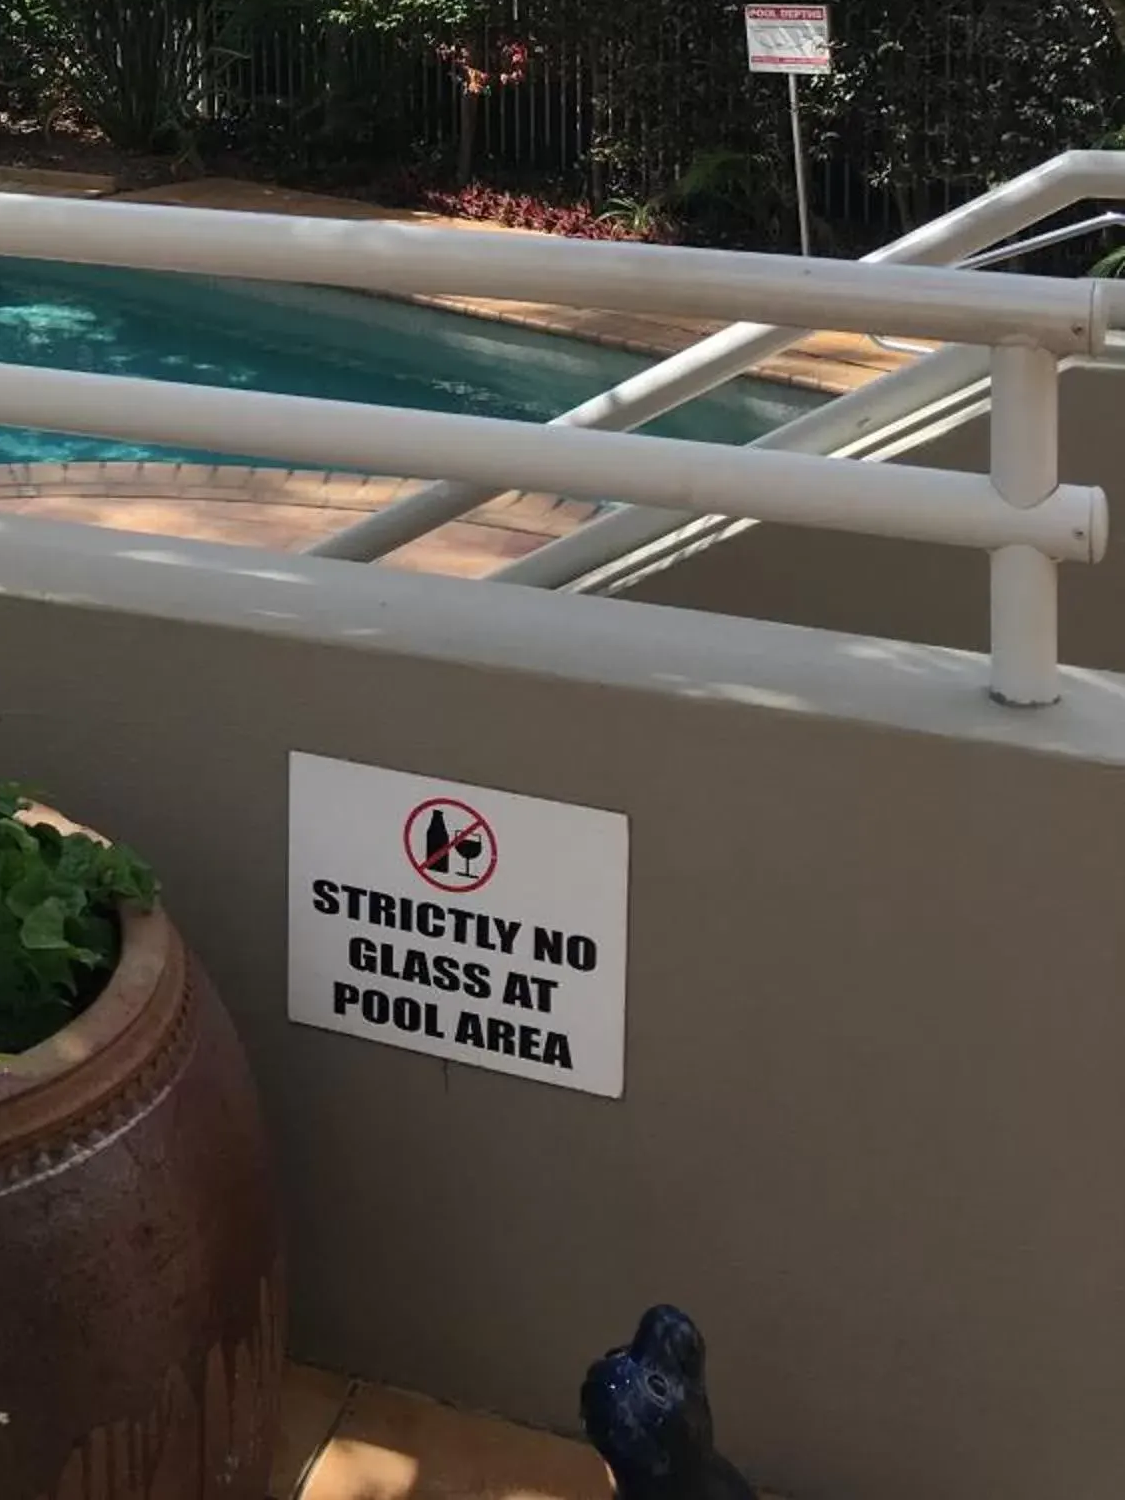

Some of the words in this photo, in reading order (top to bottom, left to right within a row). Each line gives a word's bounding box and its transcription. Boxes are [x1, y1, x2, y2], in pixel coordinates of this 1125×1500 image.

[313, 879, 522, 955] STRICTLY
[533, 926, 597, 972] NO
[348, 937, 492, 999] GLASS
[502, 971, 559, 1014] AT
[333, 980, 445, 1039] POOL
[454, 1011, 573, 1070] AREA
